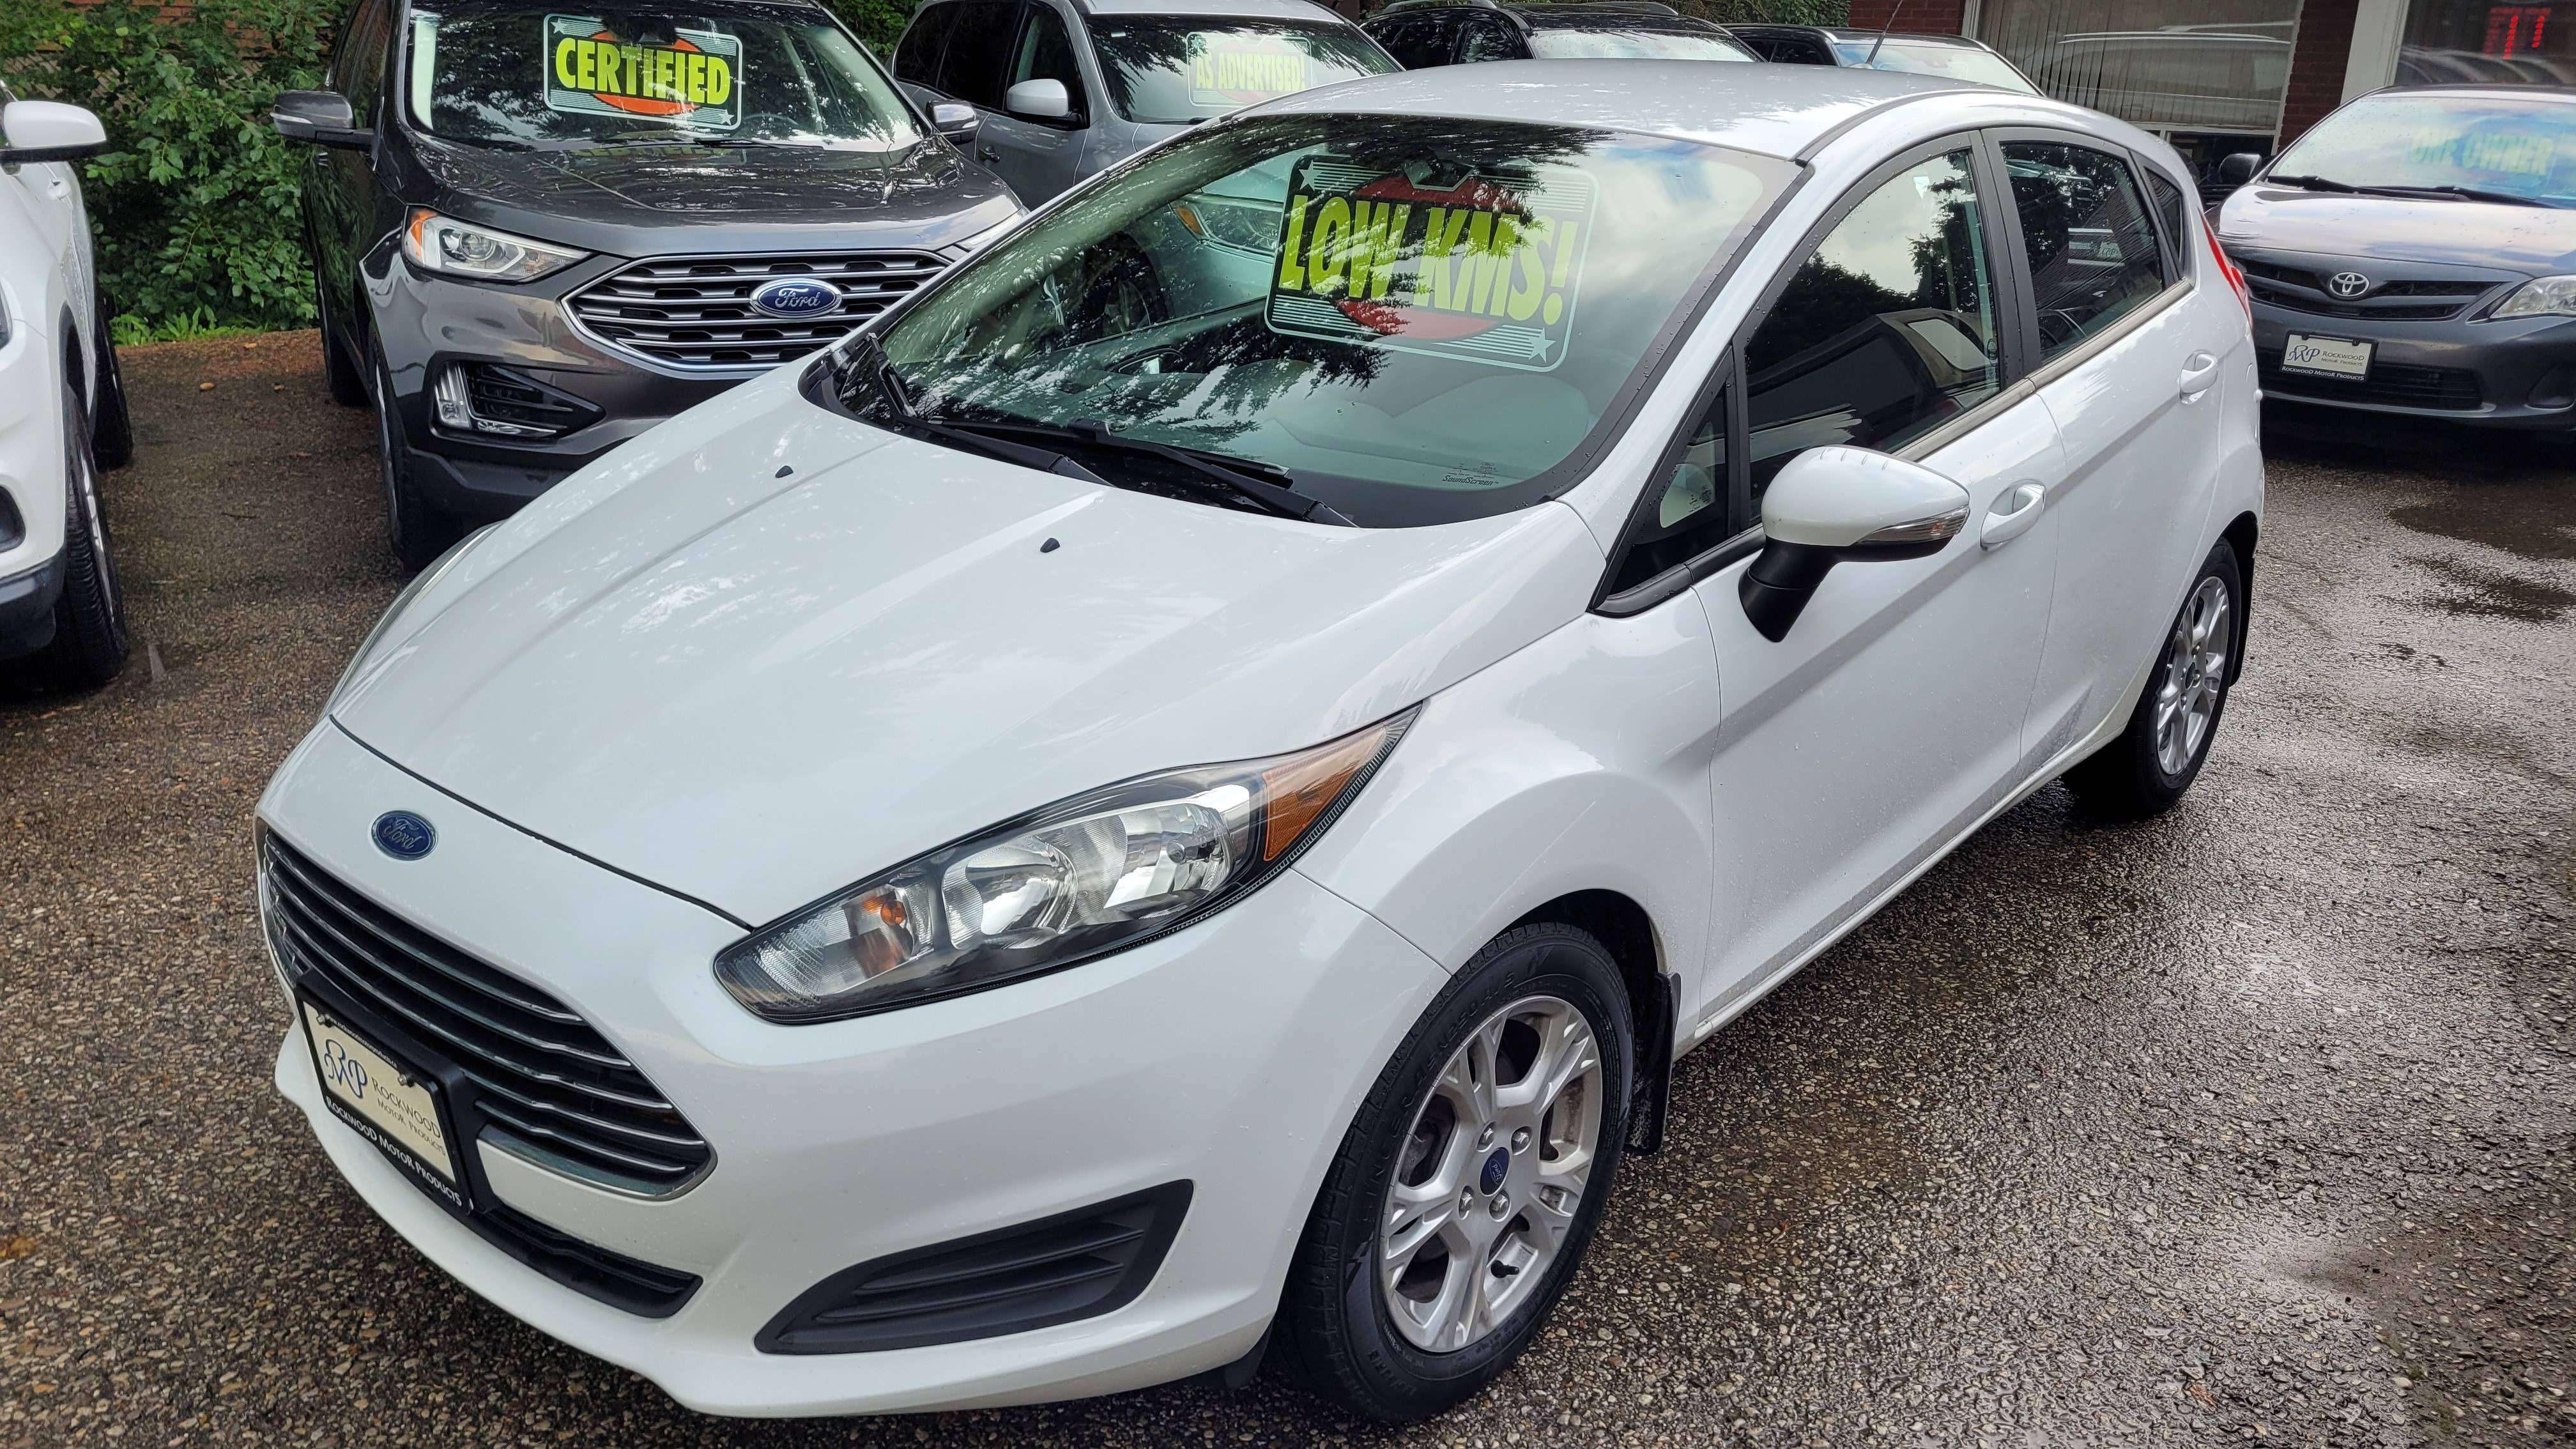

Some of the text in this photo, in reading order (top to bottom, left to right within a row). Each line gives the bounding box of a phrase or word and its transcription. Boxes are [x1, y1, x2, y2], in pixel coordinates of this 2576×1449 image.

[555, 37, 731, 105] CERTIFIED
[1195, 51, 1307, 92] AS ADVERTISED!
[2462, 132, 2554, 176] OWNER
[1278, 194, 1579, 326] LOW KMS!
[774, 288, 821, 308] Ford
[383, 818, 424, 850] Ford
[371, 1076, 441, 1139] ROCKWOOD
[326, 1096, 463, 1207] ROCKWOOD MOTOR PRODUCTS
